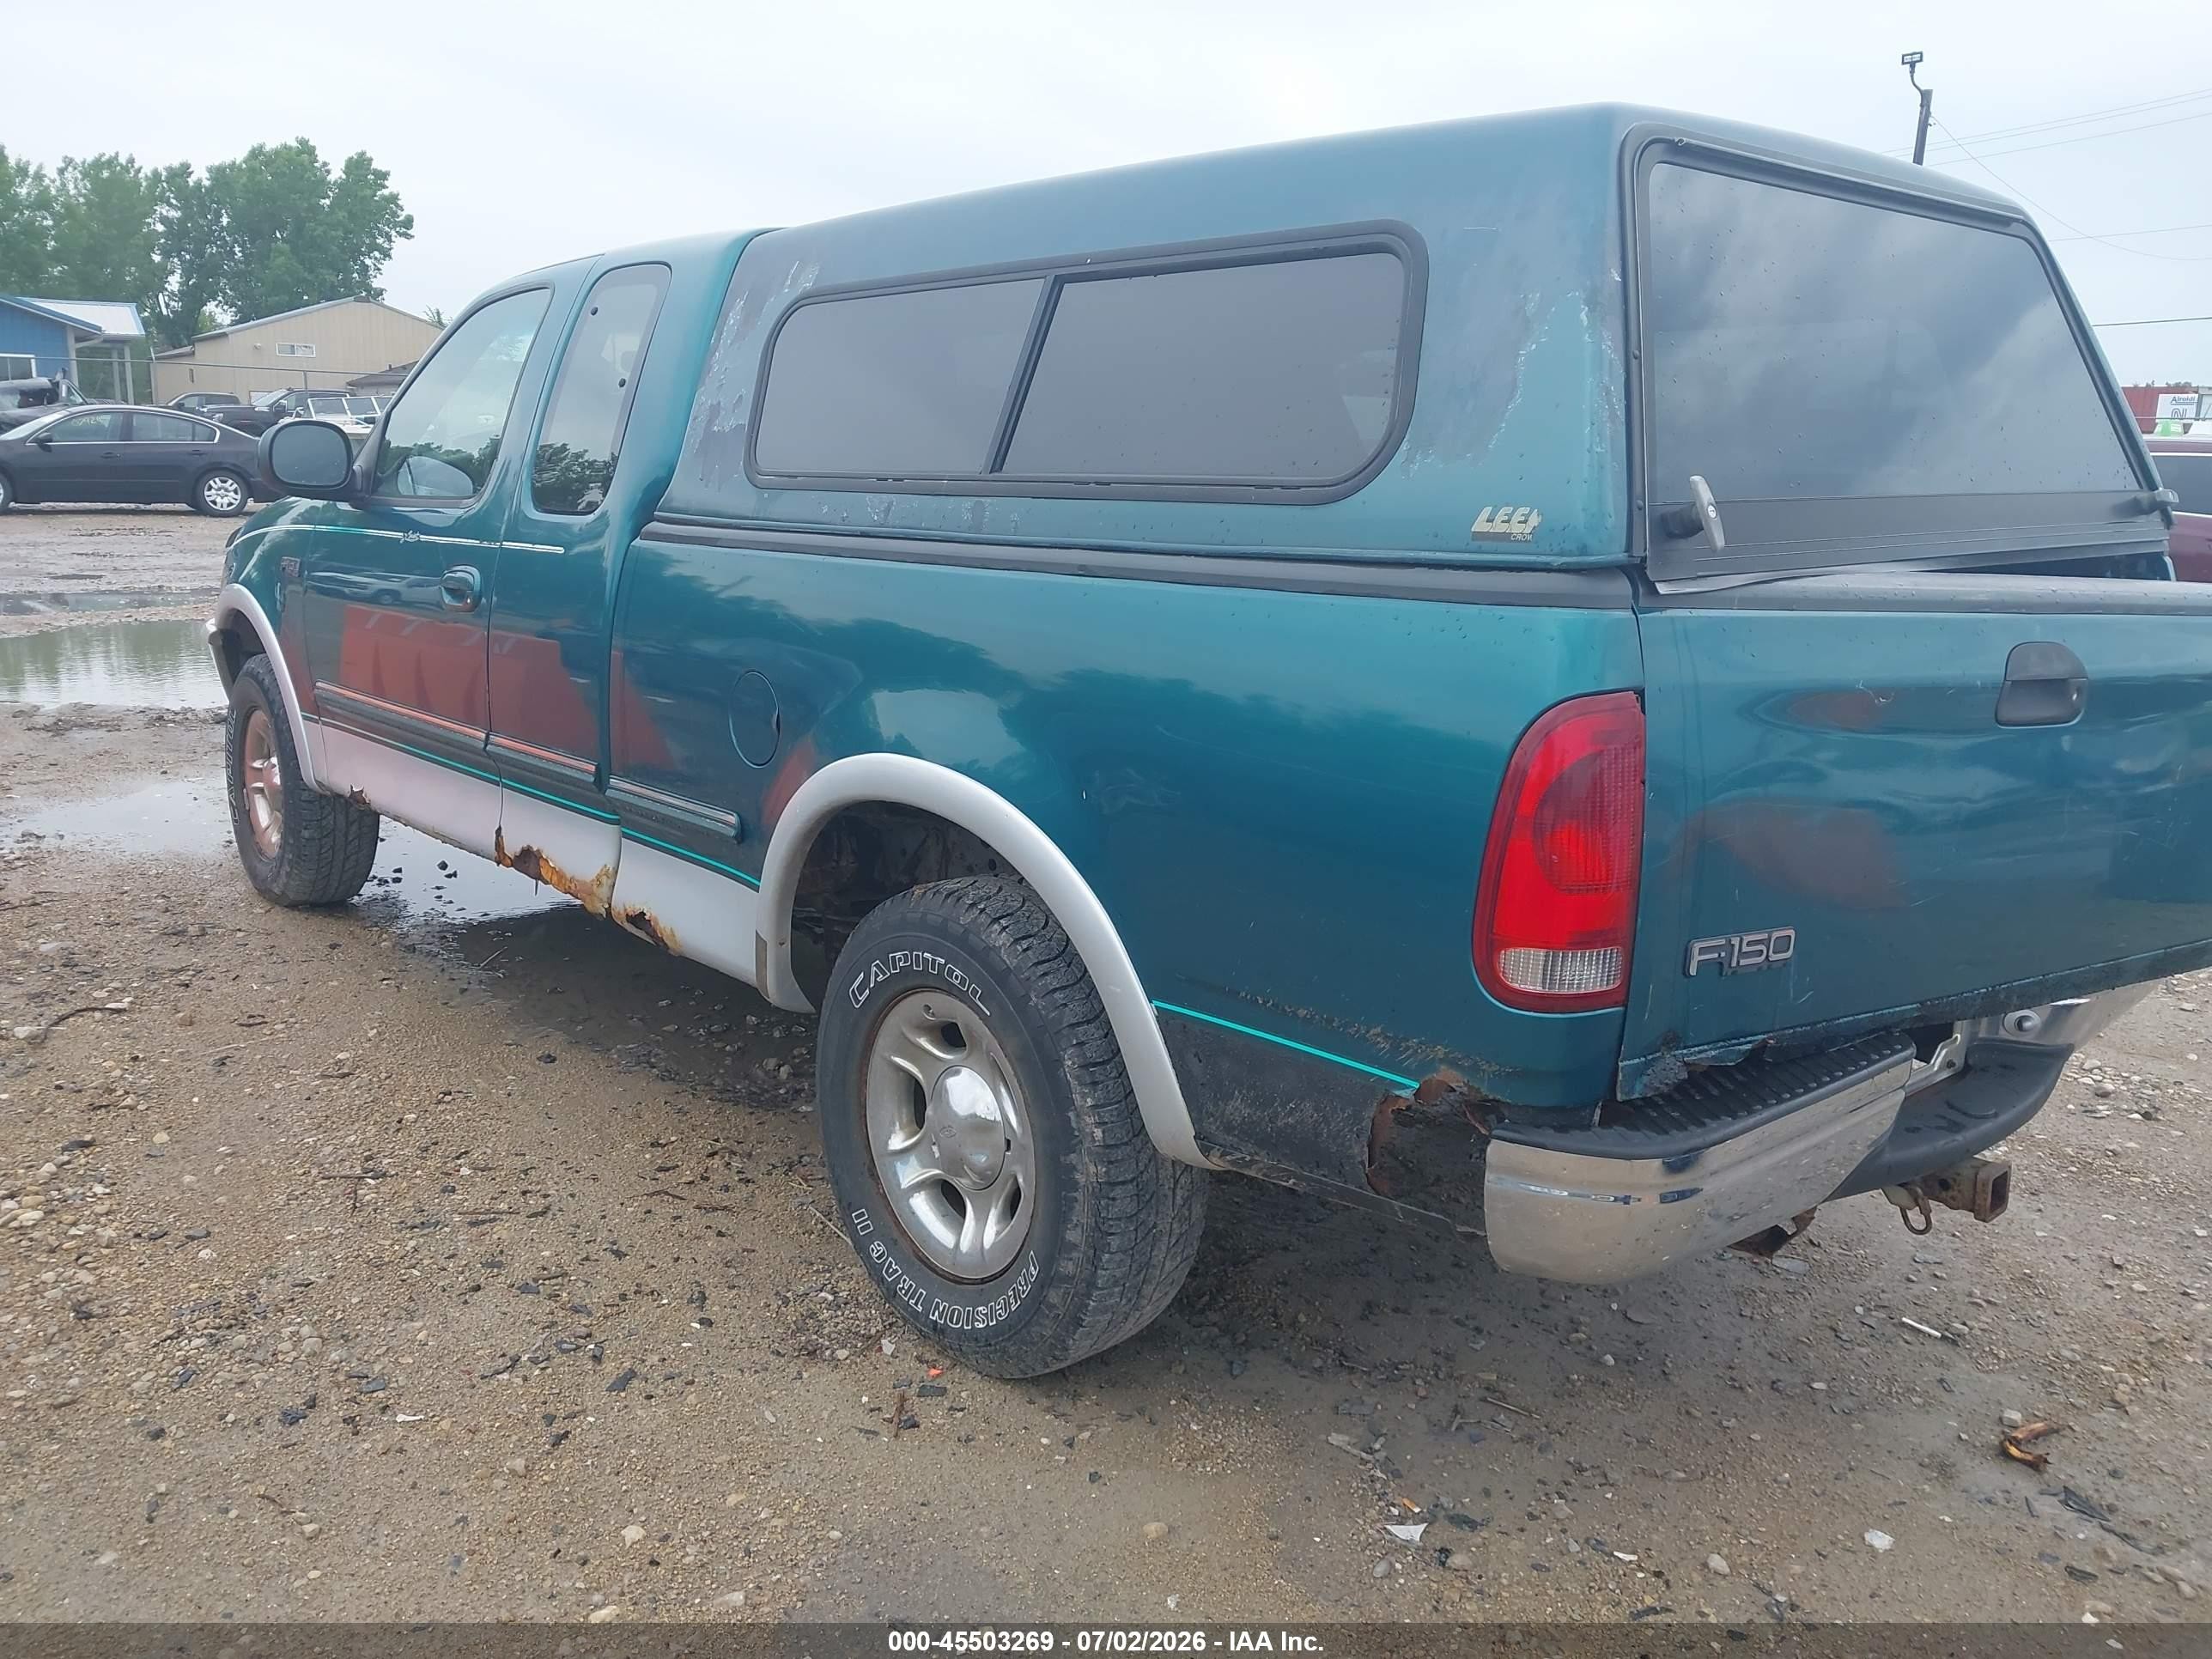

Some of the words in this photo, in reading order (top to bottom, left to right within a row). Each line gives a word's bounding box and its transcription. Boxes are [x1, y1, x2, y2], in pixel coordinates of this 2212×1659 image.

[848, 951, 990, 1017] CAPITOL
[851, 1208, 874, 1236] II
[869, 1240, 927, 1312] TRAC
[929, 1249, 1040, 1329] PRECISION
